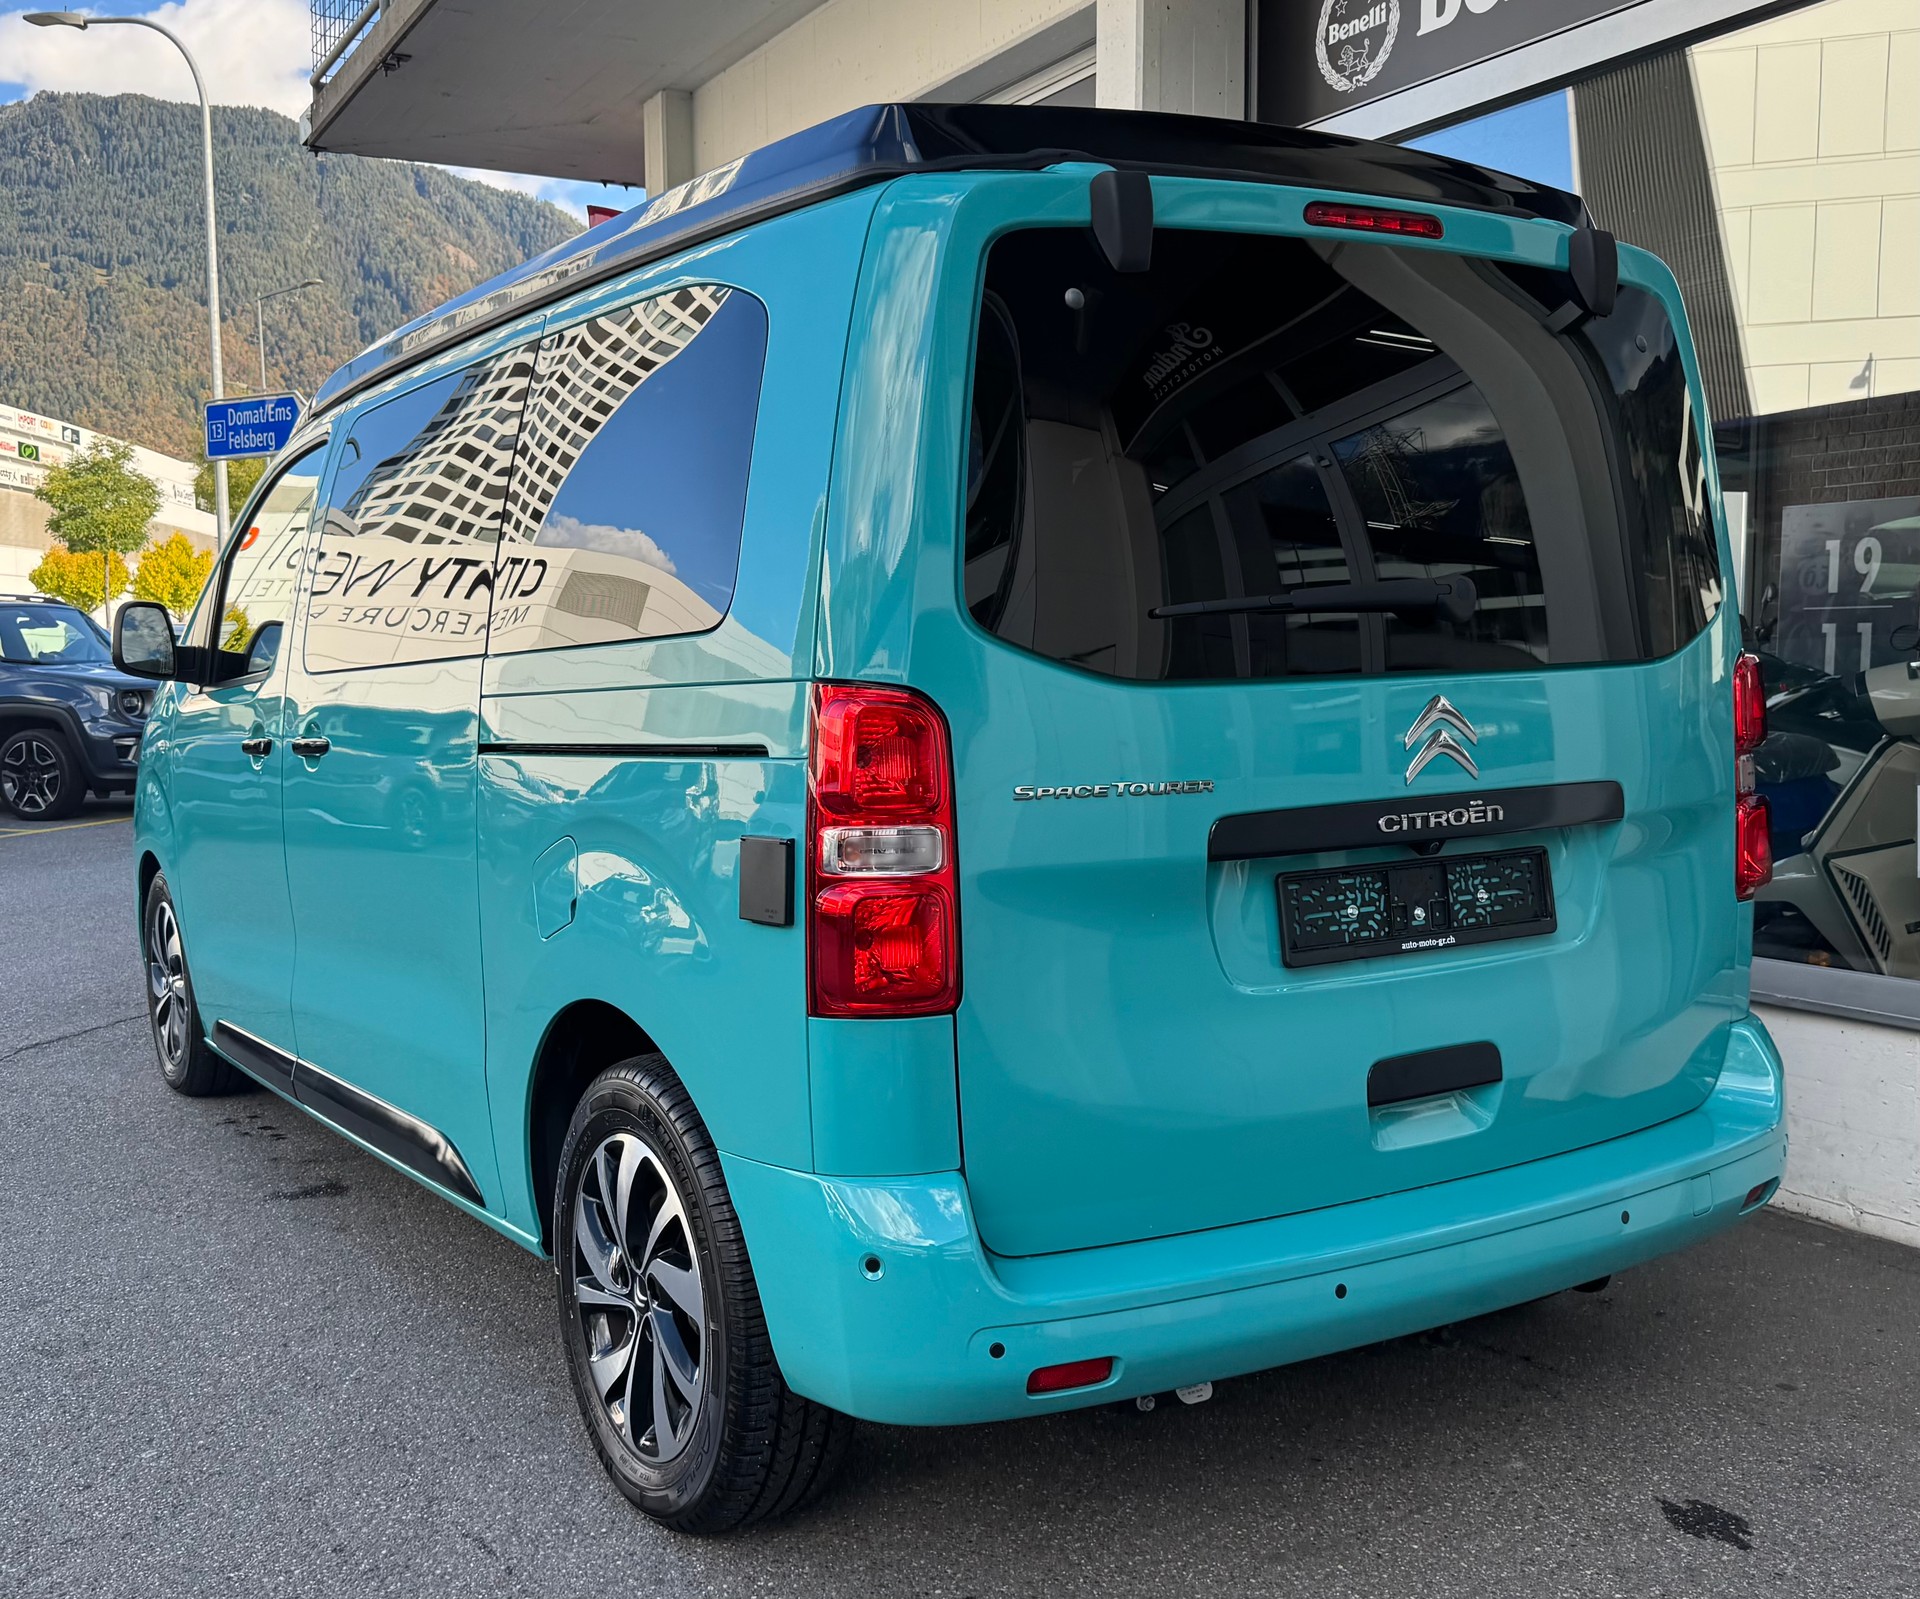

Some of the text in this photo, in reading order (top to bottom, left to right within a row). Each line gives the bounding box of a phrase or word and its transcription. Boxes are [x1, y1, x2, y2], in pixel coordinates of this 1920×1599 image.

[1328, 2, 1387, 46] Benelli
[227, 403, 292, 427] Domat/Ems
[211, 423, 223, 439] 13
[228, 428, 276, 451] Felsberg
[1825, 536, 1882, 594] 19
[1821, 622, 1873, 676] 11
[1401, 935, 1456, 950] auto-moto-gr.ch
